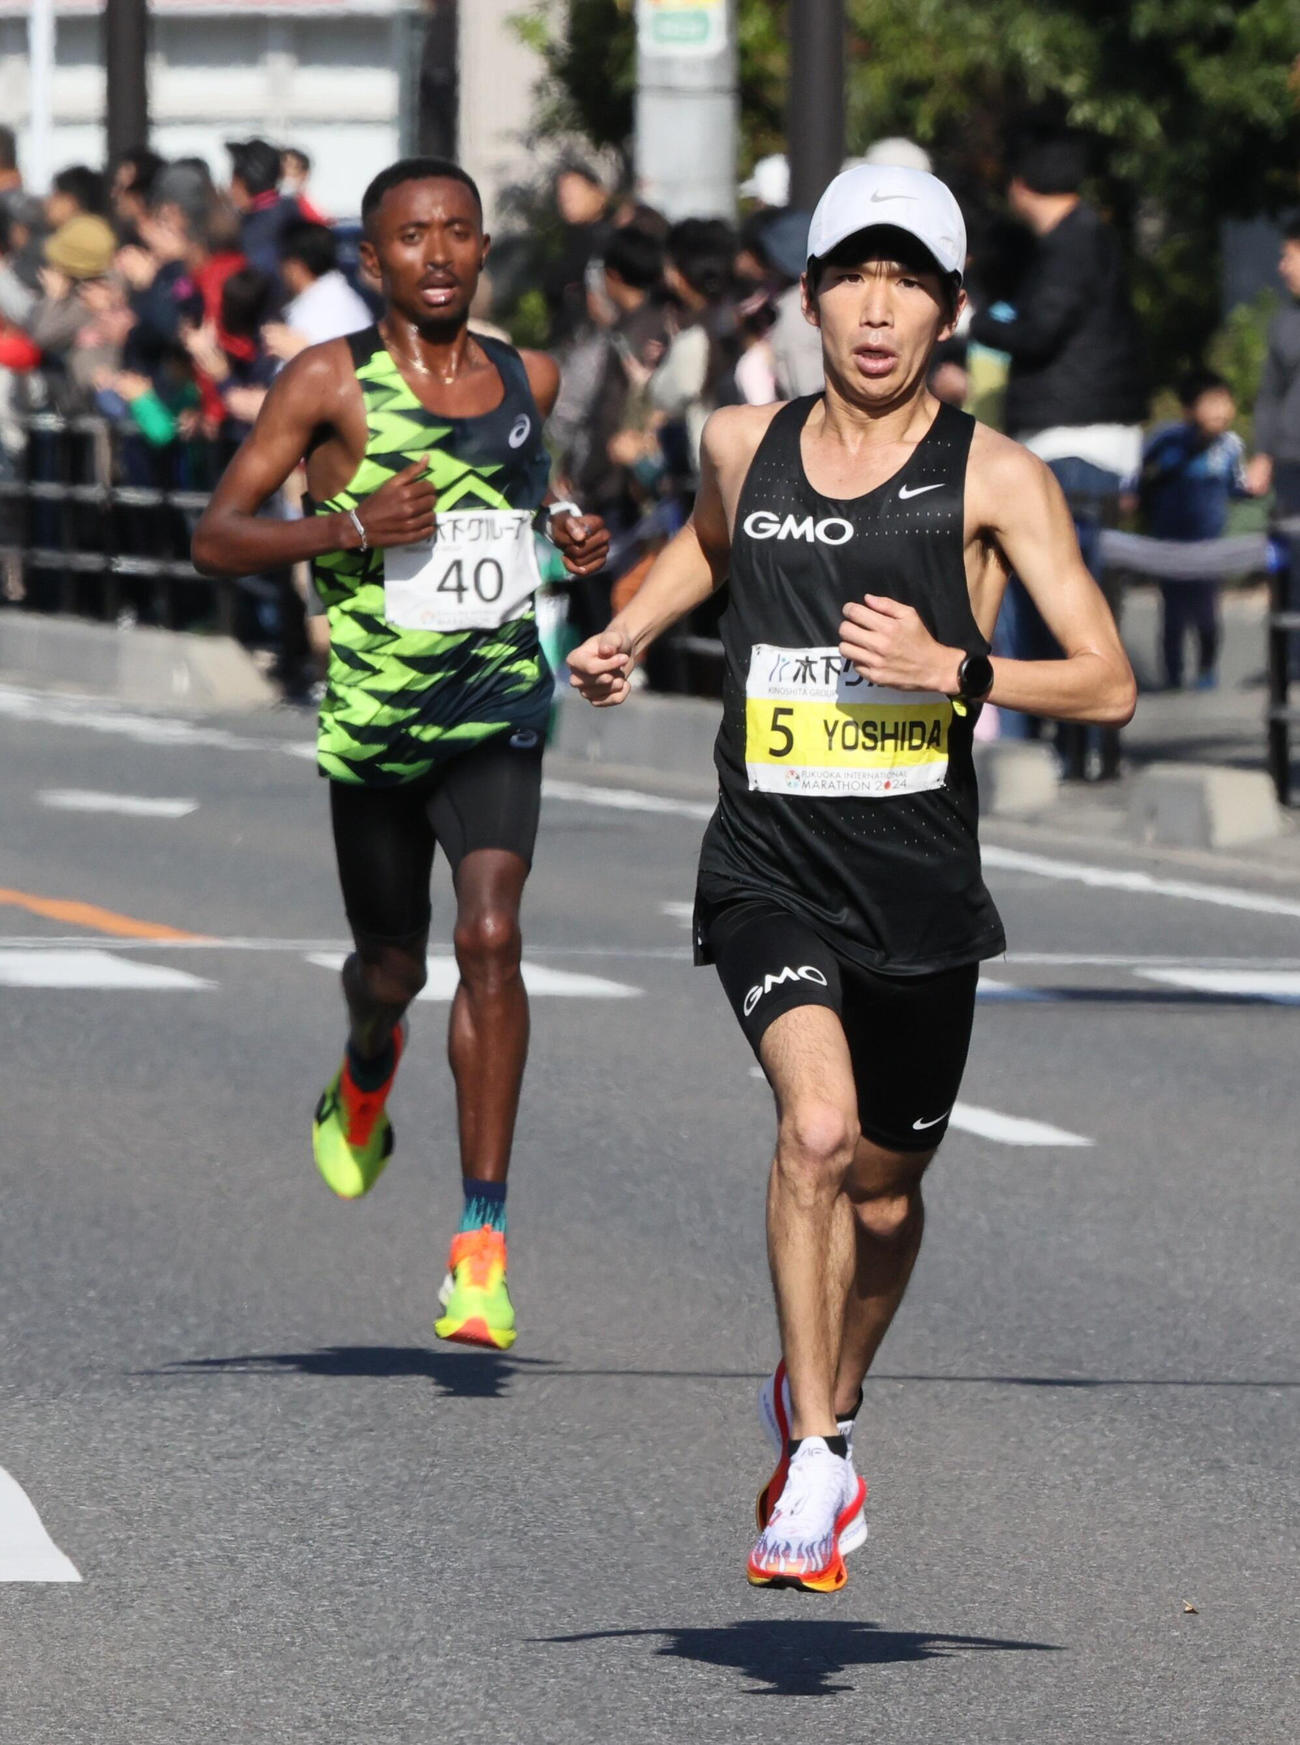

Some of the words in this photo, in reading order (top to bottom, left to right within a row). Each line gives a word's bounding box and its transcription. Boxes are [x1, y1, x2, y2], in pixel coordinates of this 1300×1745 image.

[743, 510, 855, 546] GMO
[436, 557, 504, 604] 40
[768, 706, 795, 758] 5
[823, 719, 942, 752] YOSHIDA
[801, 770, 842, 779] FUKUOKA
[844, 770, 907, 780] INTERNATIONAL
[801, 780, 871, 791] MARATHON
[743, 965, 828, 1017] GMO
